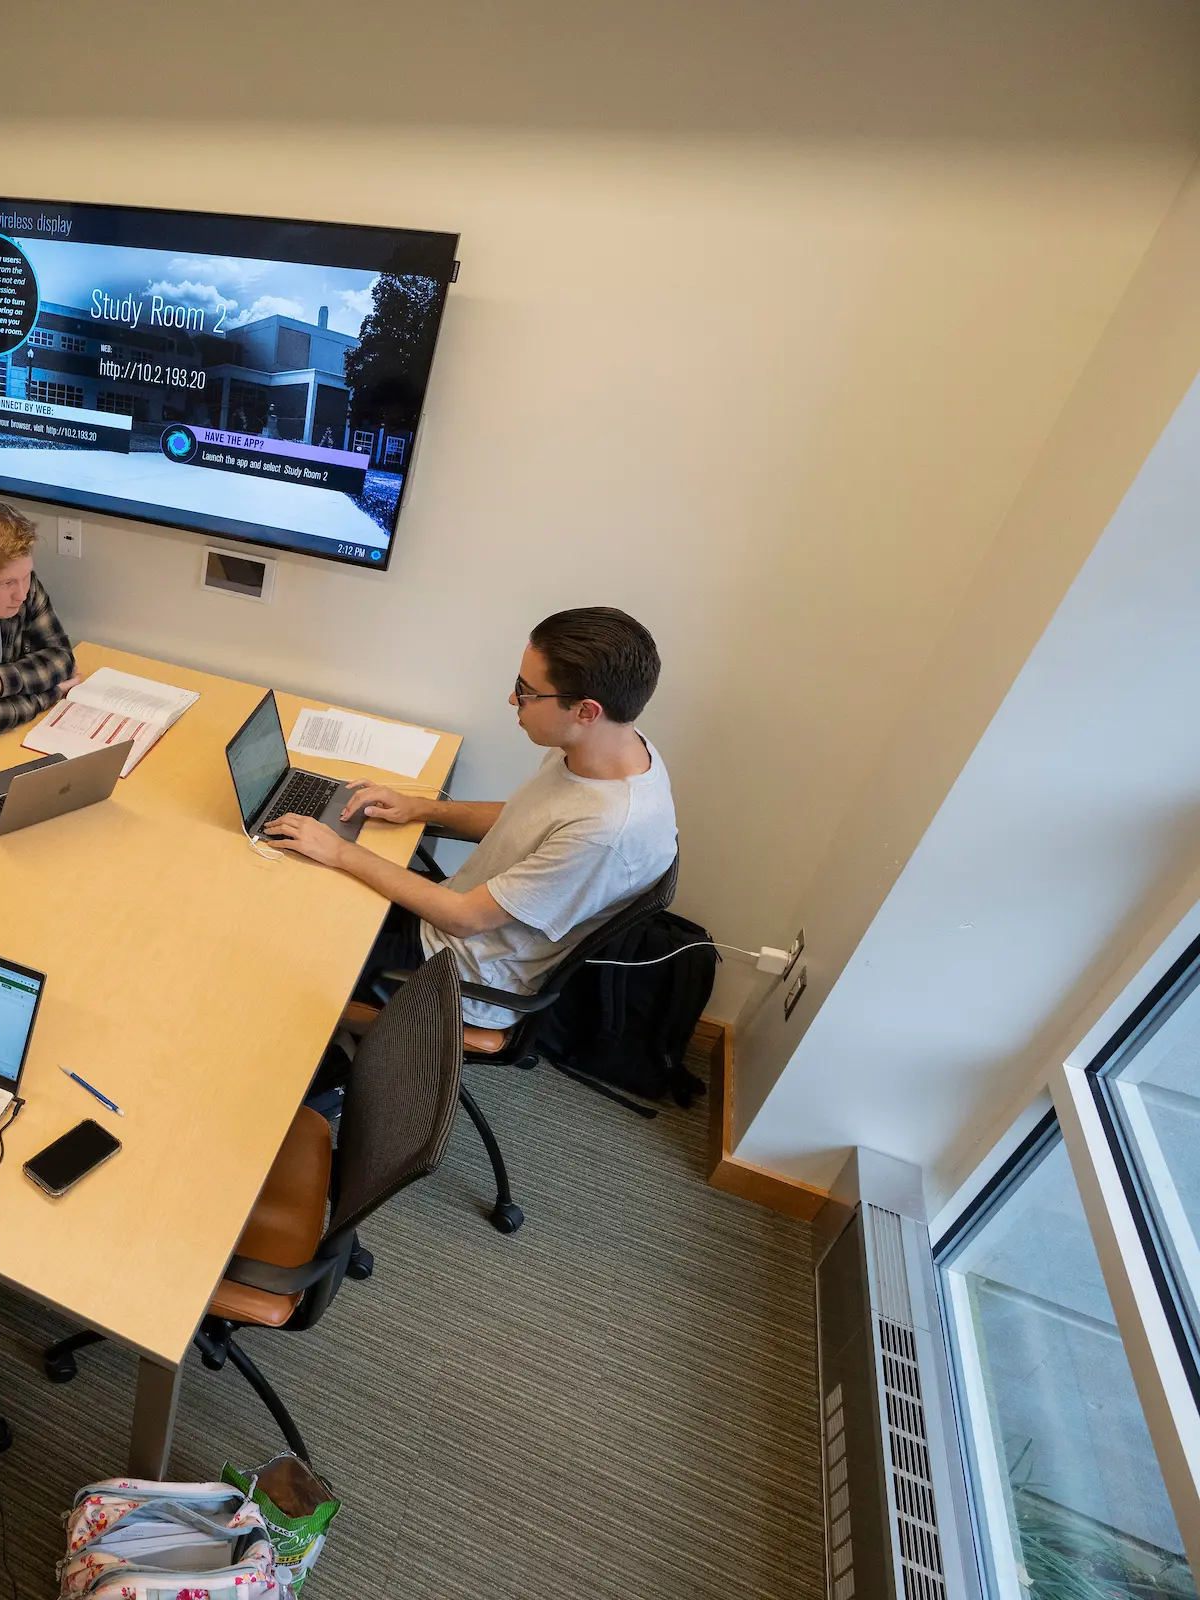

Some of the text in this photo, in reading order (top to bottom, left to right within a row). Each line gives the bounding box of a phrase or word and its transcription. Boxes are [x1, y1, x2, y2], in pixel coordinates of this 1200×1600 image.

[37, 214, 72, 236] display
[12, 298, 26, 306] turn
[91, 289, 227, 333] Study Room 2
[100, 358, 206, 389] http://10.2.193.20
[25, 403, 33, 412] BY
[36, 404, 54, 415] WEB:
[34, 424, 44, 432] visit
[46, 425, 97, 441] http://10.2.193.20
[205, 431, 264, 449] HAVE THE APP?
[202, 451, 328, 481] Launch the app and select Study Room 2
[338, 544, 366, 557] 2:12 PM
